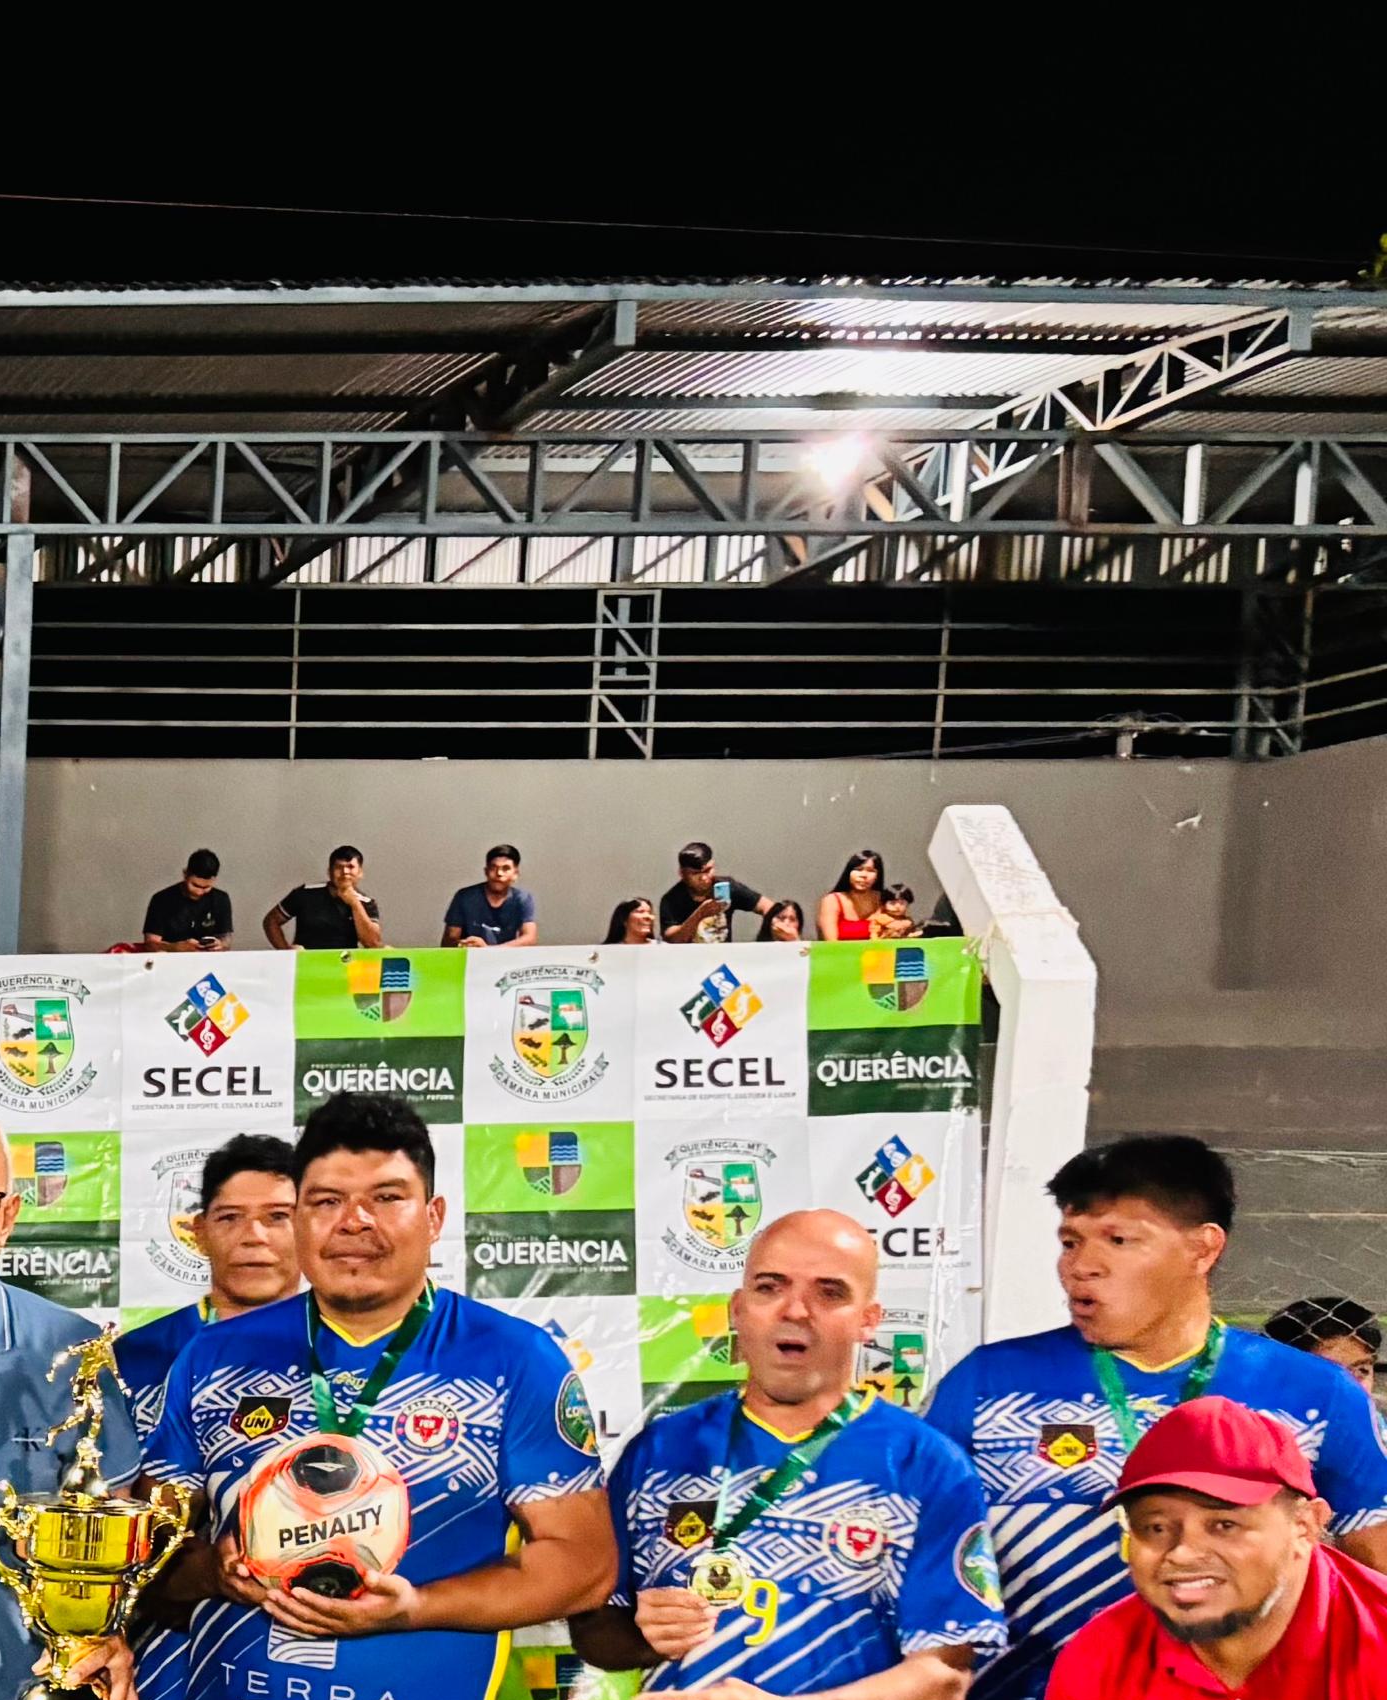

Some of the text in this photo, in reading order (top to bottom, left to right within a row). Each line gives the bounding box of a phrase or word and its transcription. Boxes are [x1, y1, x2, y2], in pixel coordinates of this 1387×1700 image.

[62, 978, 76, 987] MT
[143, 1066, 273, 1098] SECEL
[302, 1061, 455, 1097] QUERÊNCIA
[654, 1057, 786, 1089] SECEL
[817, 1051, 972, 1087] QUERÊNCIA
[29, 1081, 89, 1110] MUNICIPAL
[543, 1071, 604, 1100] MUNICIPAL
[166, 1150, 210, 1164] QUERÊN
[474, 1234, 628, 1269] QUERÊNCIA
[867, 1227, 960, 1258] CEL
[153, 1255, 197, 1282] CÂMARA
[244, 1417, 271, 1430] UNI
[278, 1505, 384, 1549] PENALTY
[742, 1578, 779, 1646] 9
